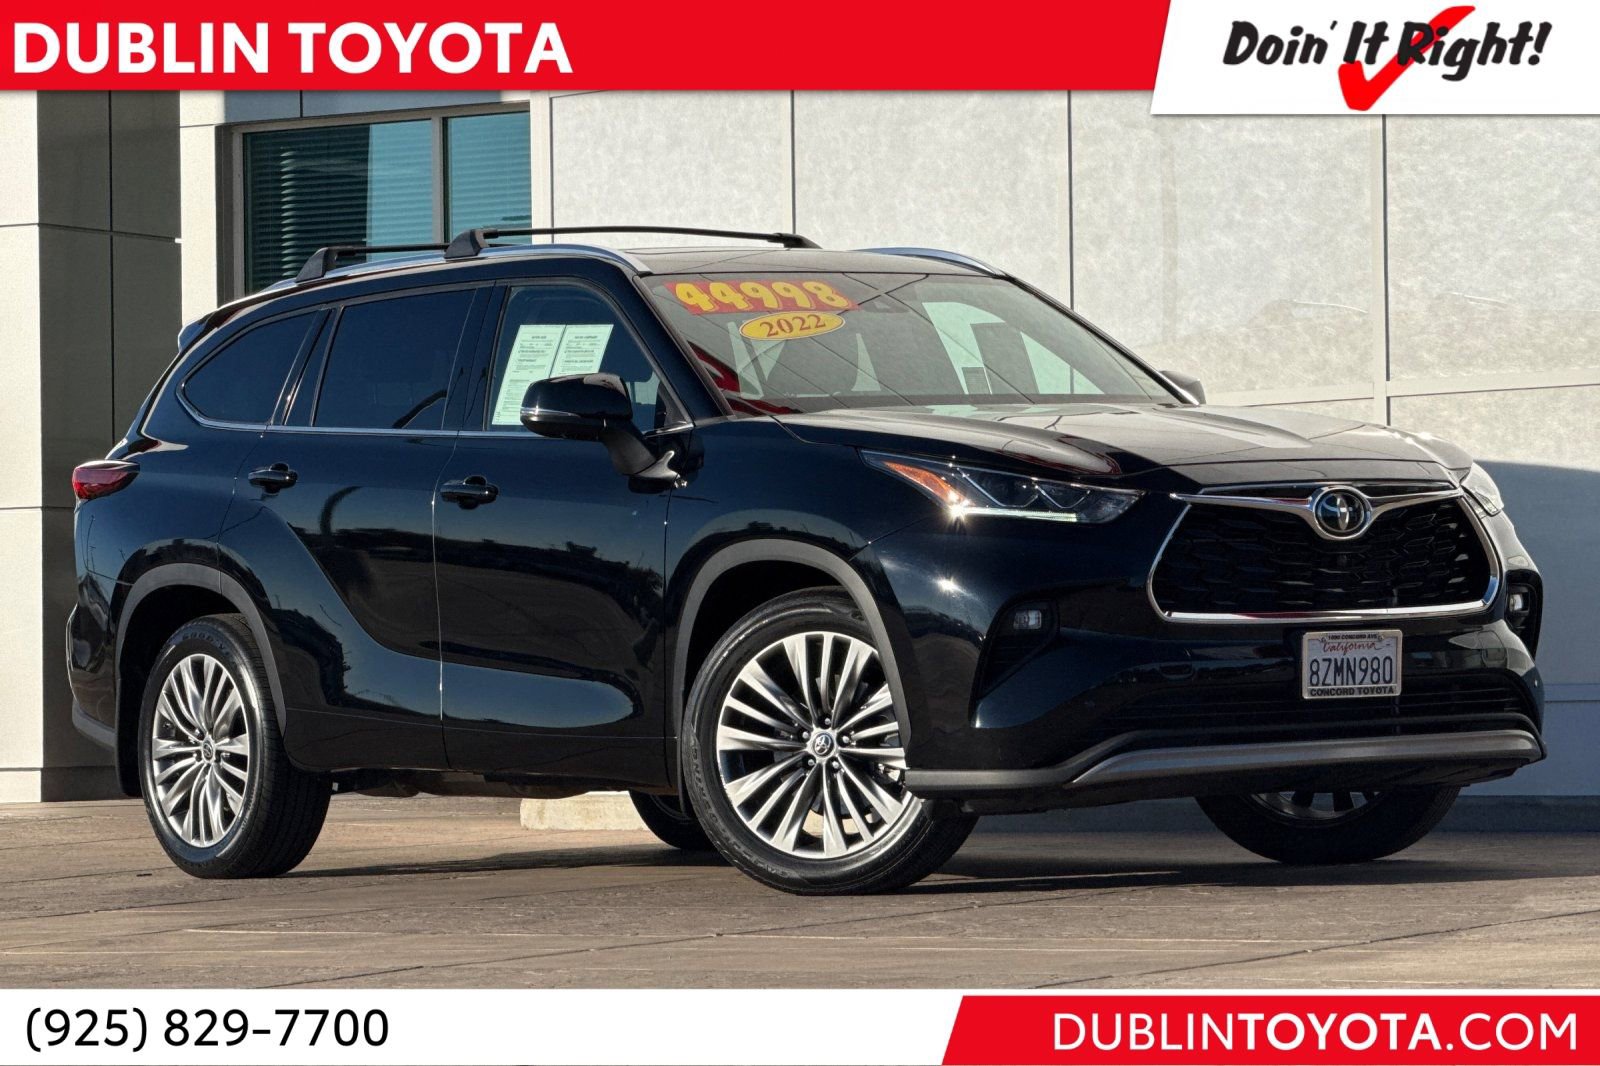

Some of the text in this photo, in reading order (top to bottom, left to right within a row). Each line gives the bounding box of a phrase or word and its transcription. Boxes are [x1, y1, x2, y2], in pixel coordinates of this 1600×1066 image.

[675, 281, 849, 312] 44998
[760, 313, 826, 338] 2022
[1322, 642, 1383, 656] California
[1309, 655, 1393, 686] 8ZMN980
[1310, 686, 1394, 697] CONCORD TOYOTA
